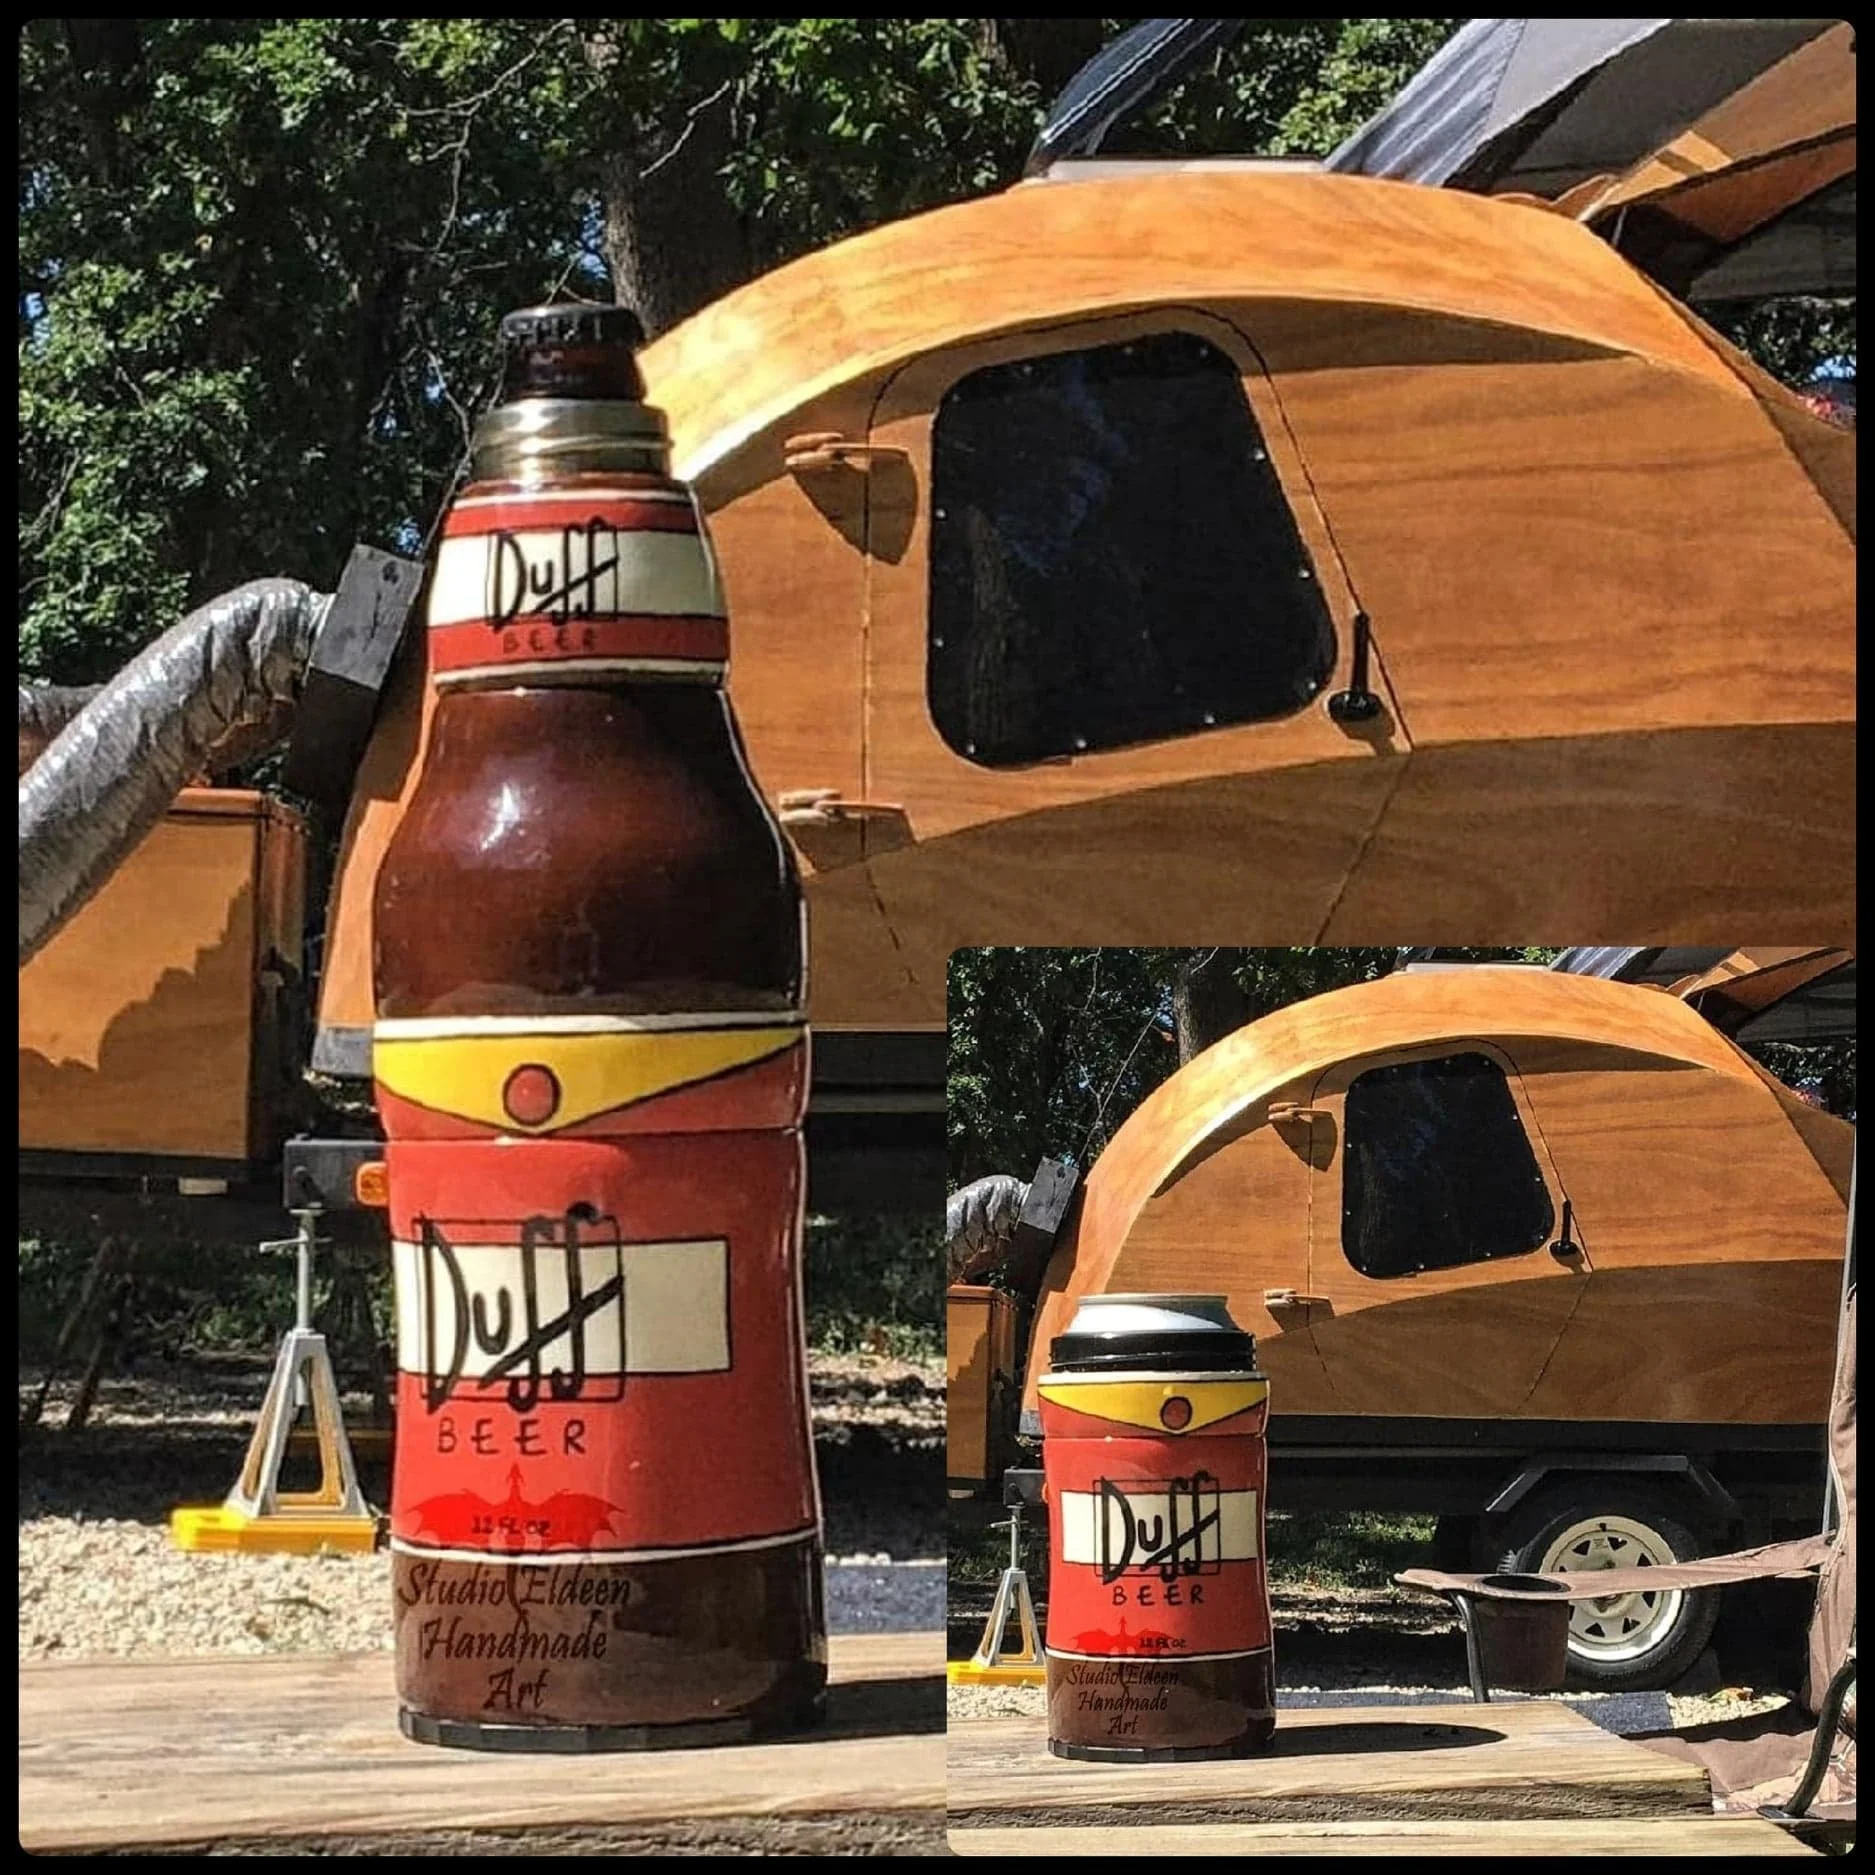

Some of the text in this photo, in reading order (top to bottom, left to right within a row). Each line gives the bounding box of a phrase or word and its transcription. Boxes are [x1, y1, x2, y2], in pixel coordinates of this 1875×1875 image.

[490, 515, 619, 630] Duff
[502, 628, 598, 654] BEER
[419, 1202, 624, 1415] Duff
[437, 1417, 586, 1455] BEER
[1100, 1470, 1220, 1586] Duff
[1112, 1584, 1204, 1606] BEER
